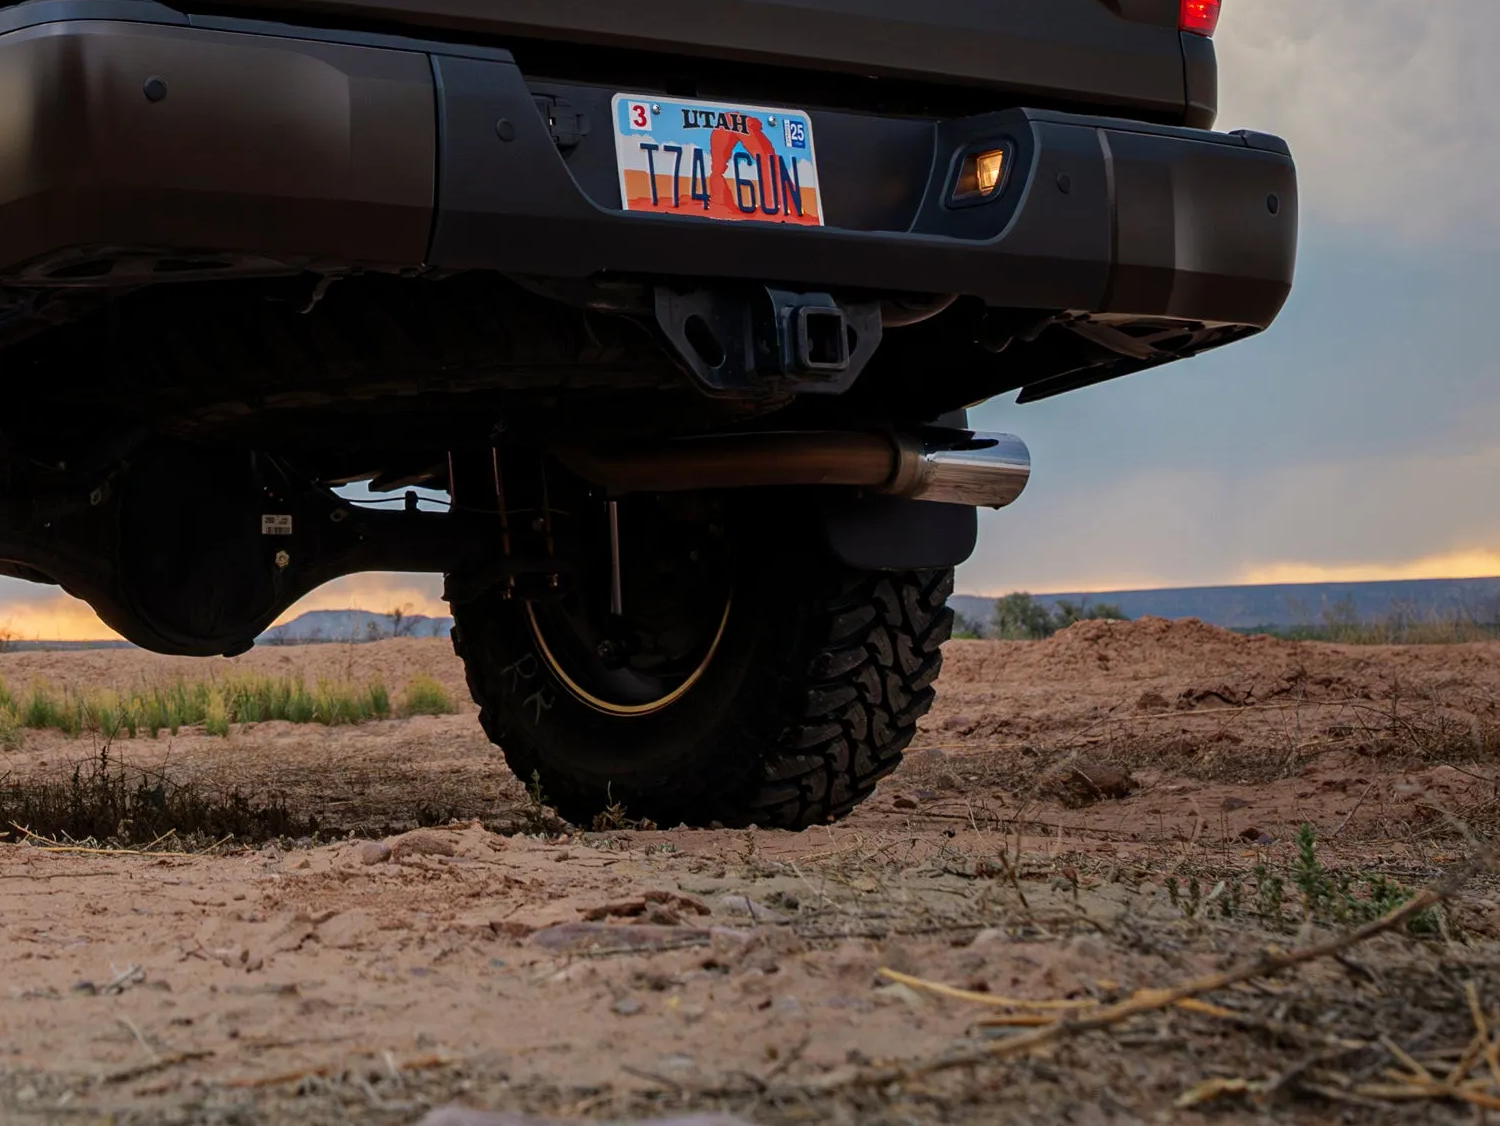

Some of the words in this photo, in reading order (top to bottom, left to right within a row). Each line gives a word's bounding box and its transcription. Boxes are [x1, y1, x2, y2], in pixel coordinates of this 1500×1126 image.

[632, 105, 648, 128] 3
[681, 108, 750, 135] UTAH
[790, 123, 804, 141] 25
[640, 143, 711, 210] T74
